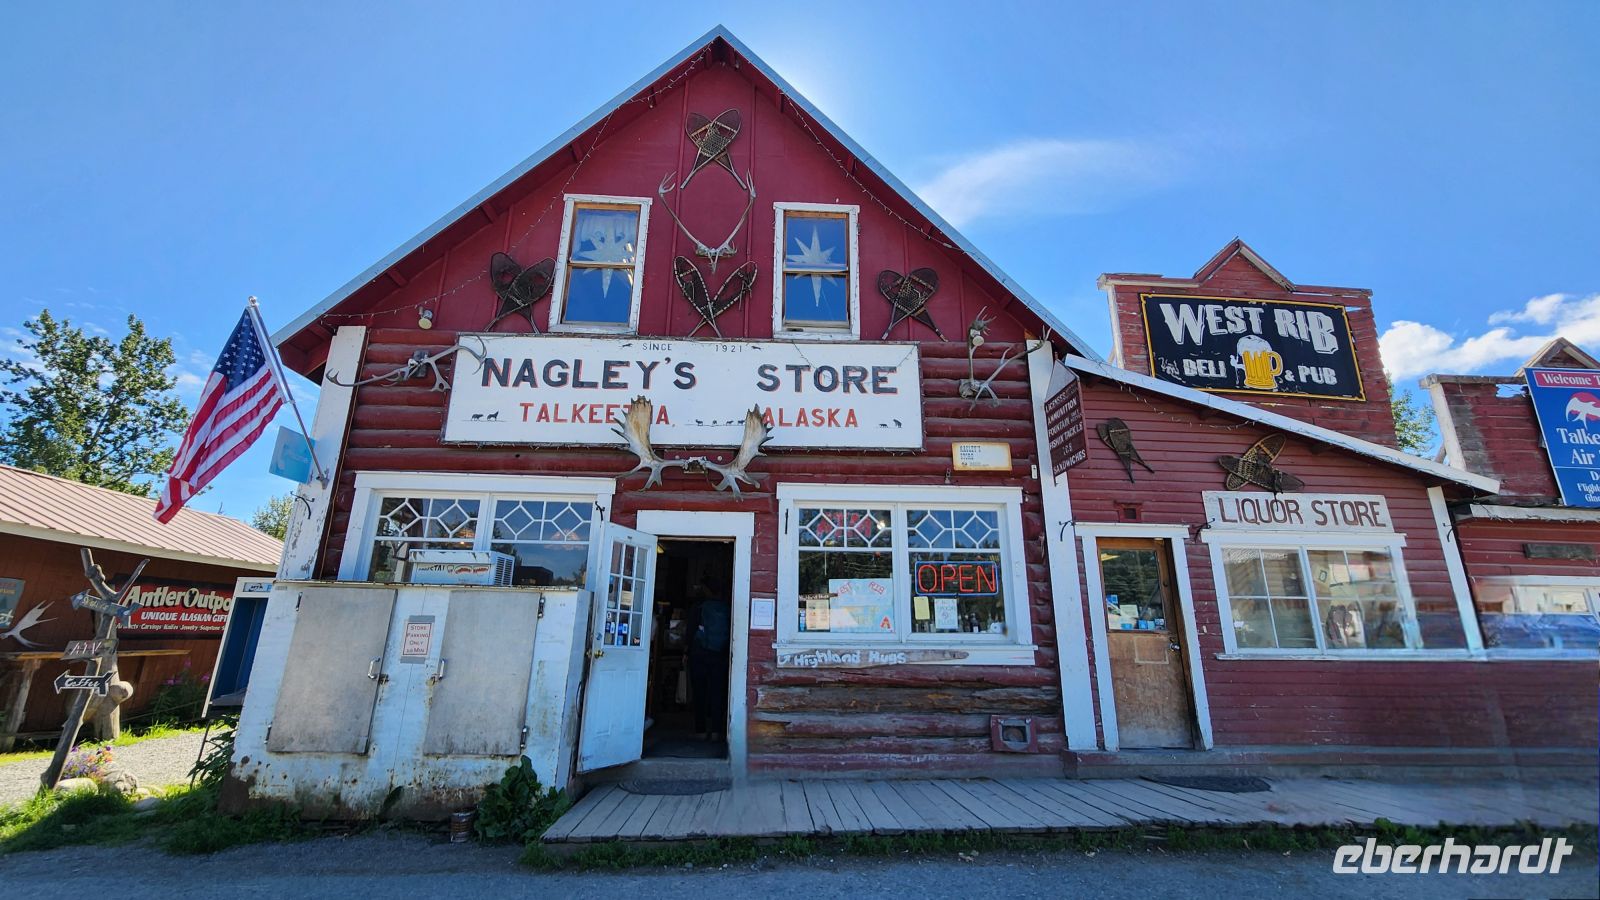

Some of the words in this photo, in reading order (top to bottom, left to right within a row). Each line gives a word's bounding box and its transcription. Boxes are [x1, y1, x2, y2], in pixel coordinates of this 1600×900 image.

[1159, 303, 1264, 345] WEST
[1274, 308, 1339, 355] RIB
[642, 342, 673, 352] SINCE
[715, 344, 743, 353] 1921
[481, 356, 697, 391] NAGLEY'S
[756, 363, 900, 395] STORE
[1182, 358, 1227, 379] DELI
[1284, 370, 1296, 382] &
[1298, 365, 1337, 386] PUB
[1542, 373, 1593, 386] Welcome
[762, 407, 858, 428] ALASKA
[1571, 448, 1596, 465] Air
[1217, 497, 1305, 526] LIQUOR
[1311, 499, 1387, 528] STORE
[918, 564, 997, 593] OPEN
[141, 611, 178, 621] UNIQUE
[179, 612, 212, 622] ALASKAN
